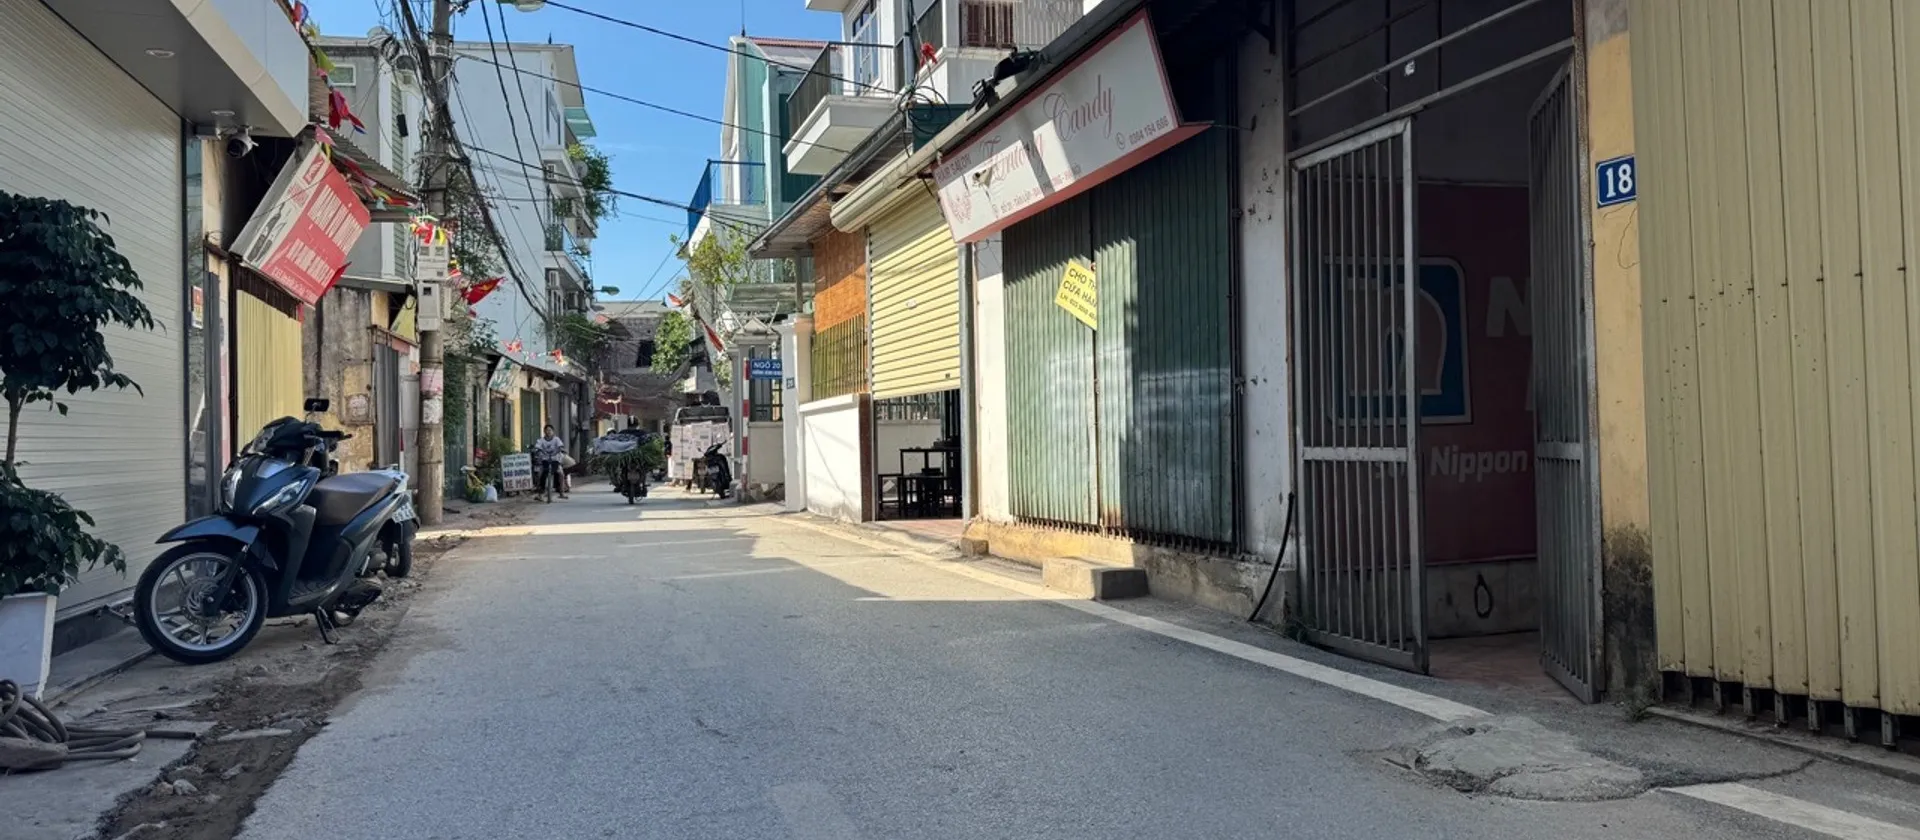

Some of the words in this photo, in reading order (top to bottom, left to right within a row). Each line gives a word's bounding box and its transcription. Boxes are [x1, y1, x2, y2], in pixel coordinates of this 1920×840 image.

[1043, 75, 1115, 141] Candy
[1606, 163, 1633, 198] 18
[1069, 268, 1087, 284] CHO
[1430, 445, 1529, 483] Nippon
